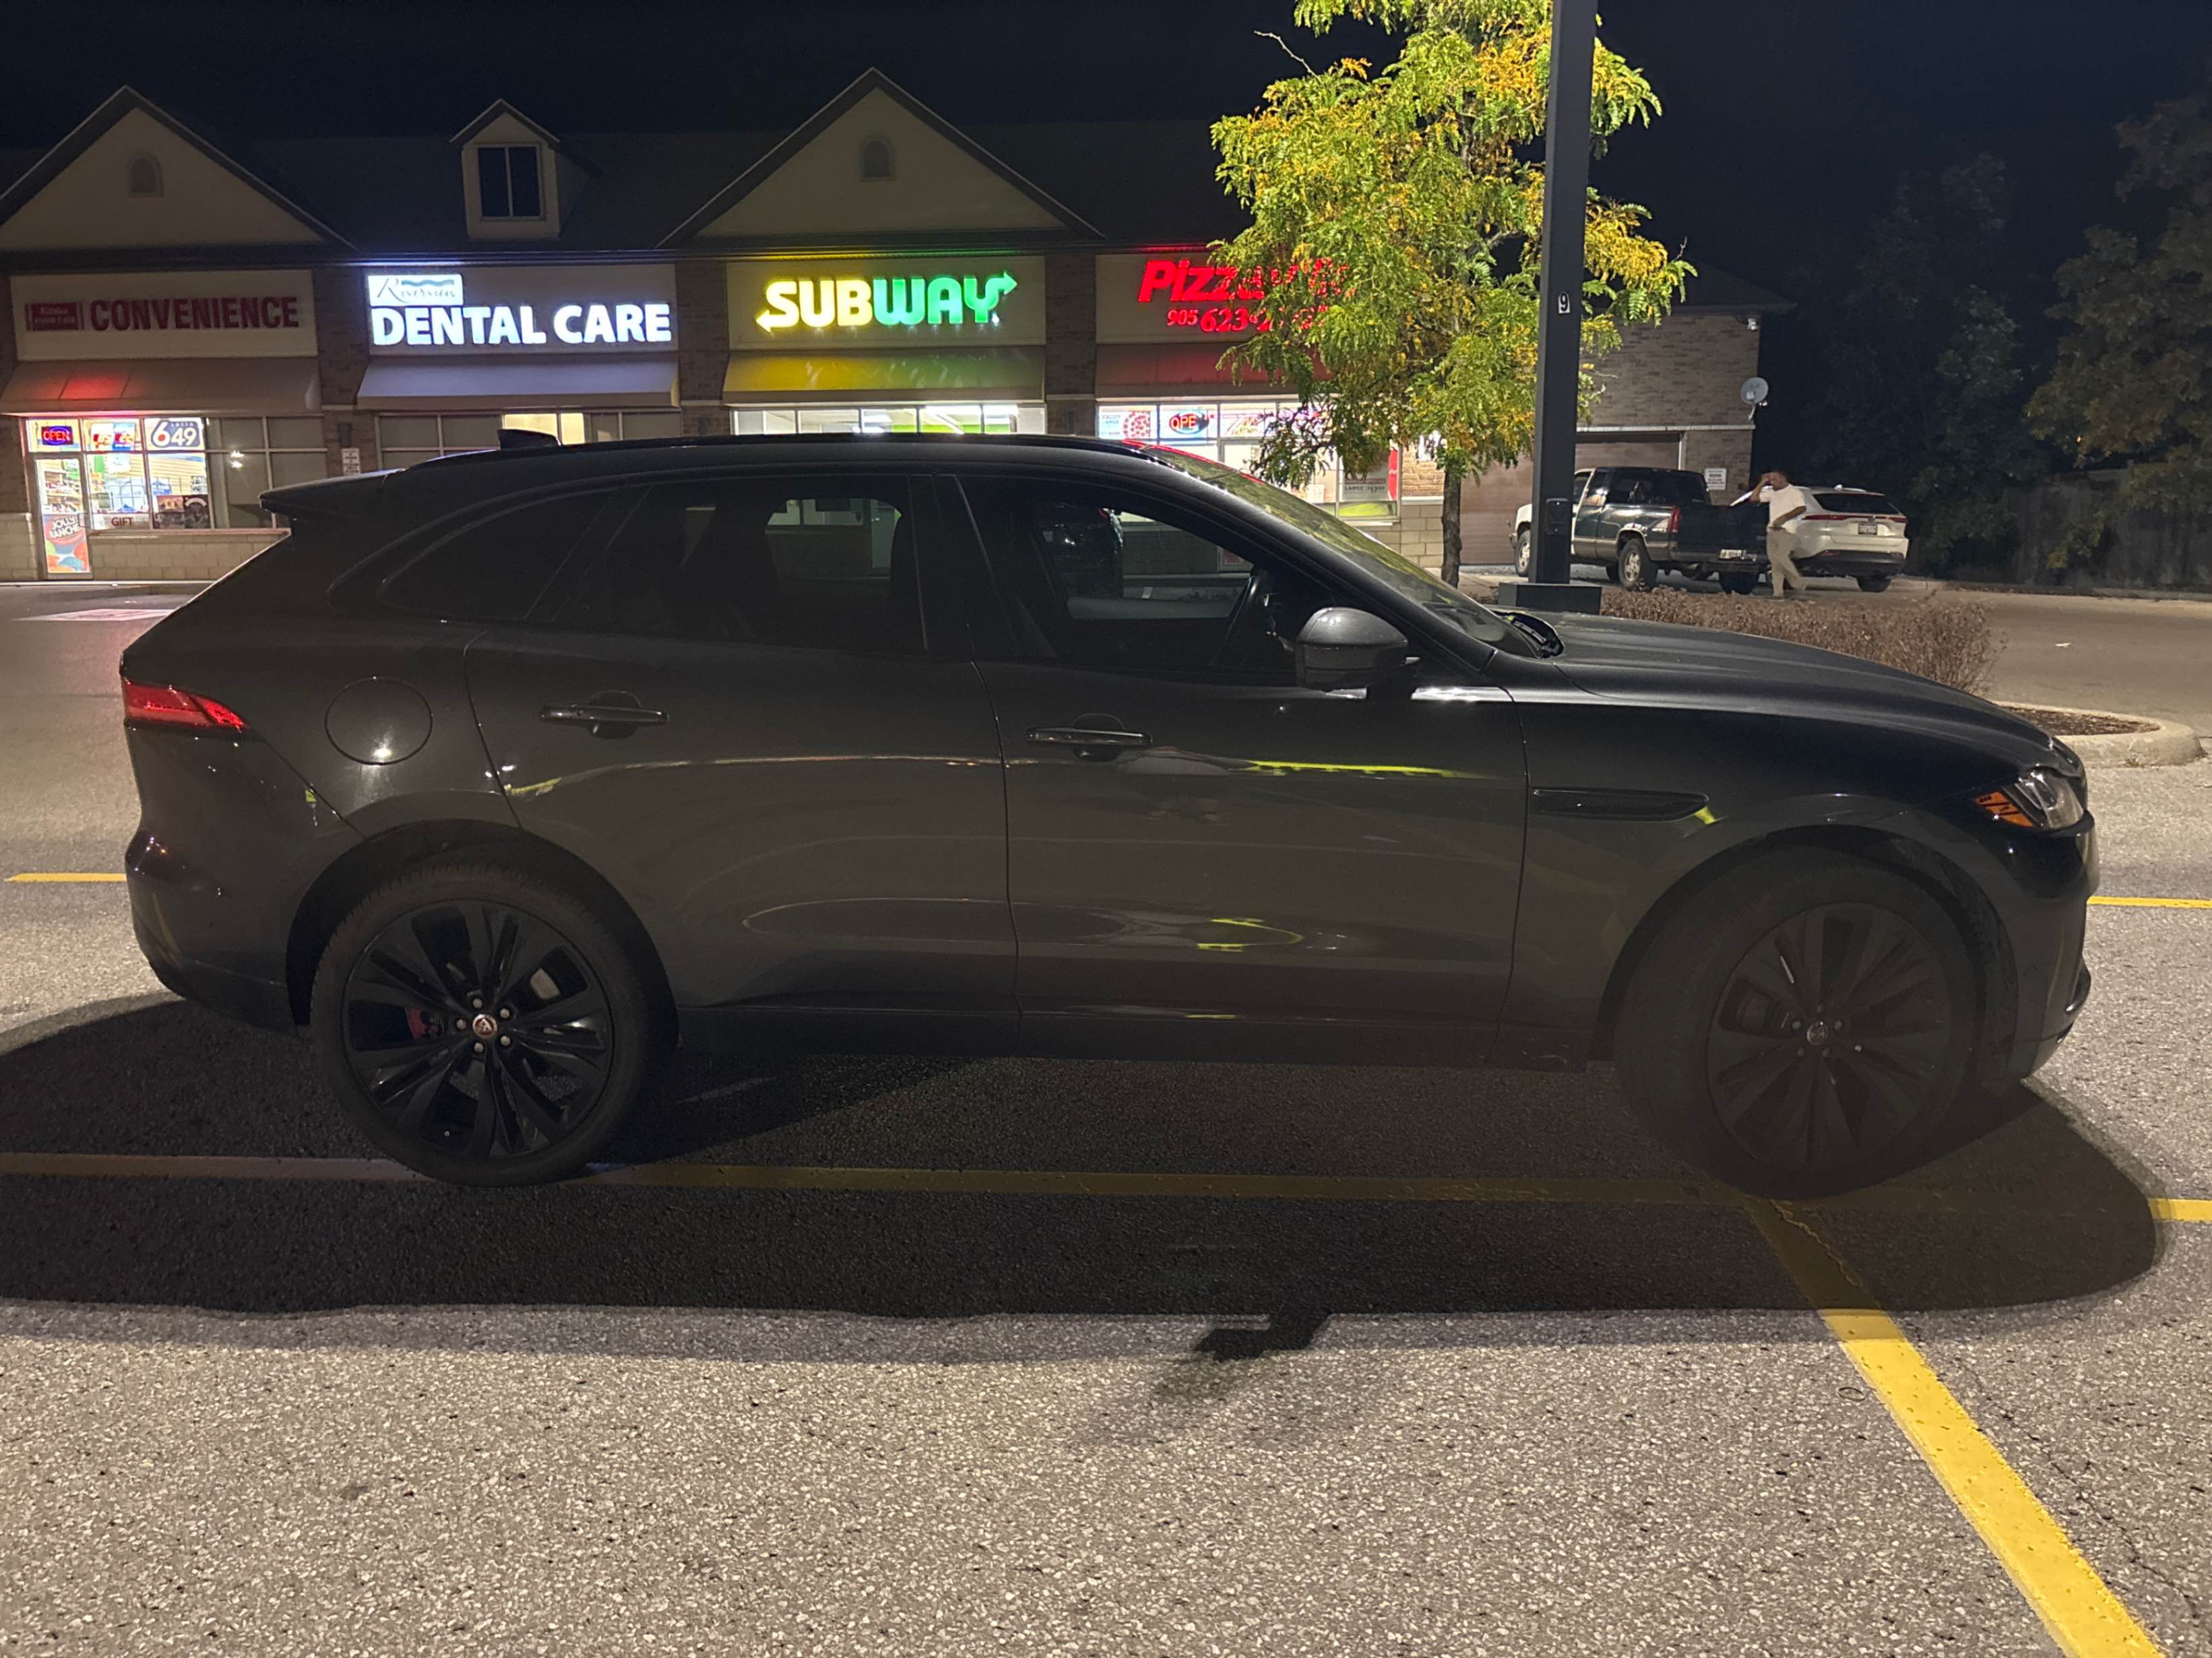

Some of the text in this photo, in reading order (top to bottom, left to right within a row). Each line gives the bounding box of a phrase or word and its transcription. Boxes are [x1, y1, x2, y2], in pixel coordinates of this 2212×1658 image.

[377, 278, 455, 302] Riverview
[755, 272, 1017, 332] SUBWAY
[1560, 292, 1569, 312] 9
[90, 296, 299, 331] CONVENIENCE
[1167, 308, 1199, 326] 905
[371, 303, 672, 345] DENTAL CARE
[1171, 415, 1200, 429] OPE
[43, 431, 70, 441] OPEN
[53, 516, 75, 530] JOLLY
[111, 517, 133, 526] GIFT
